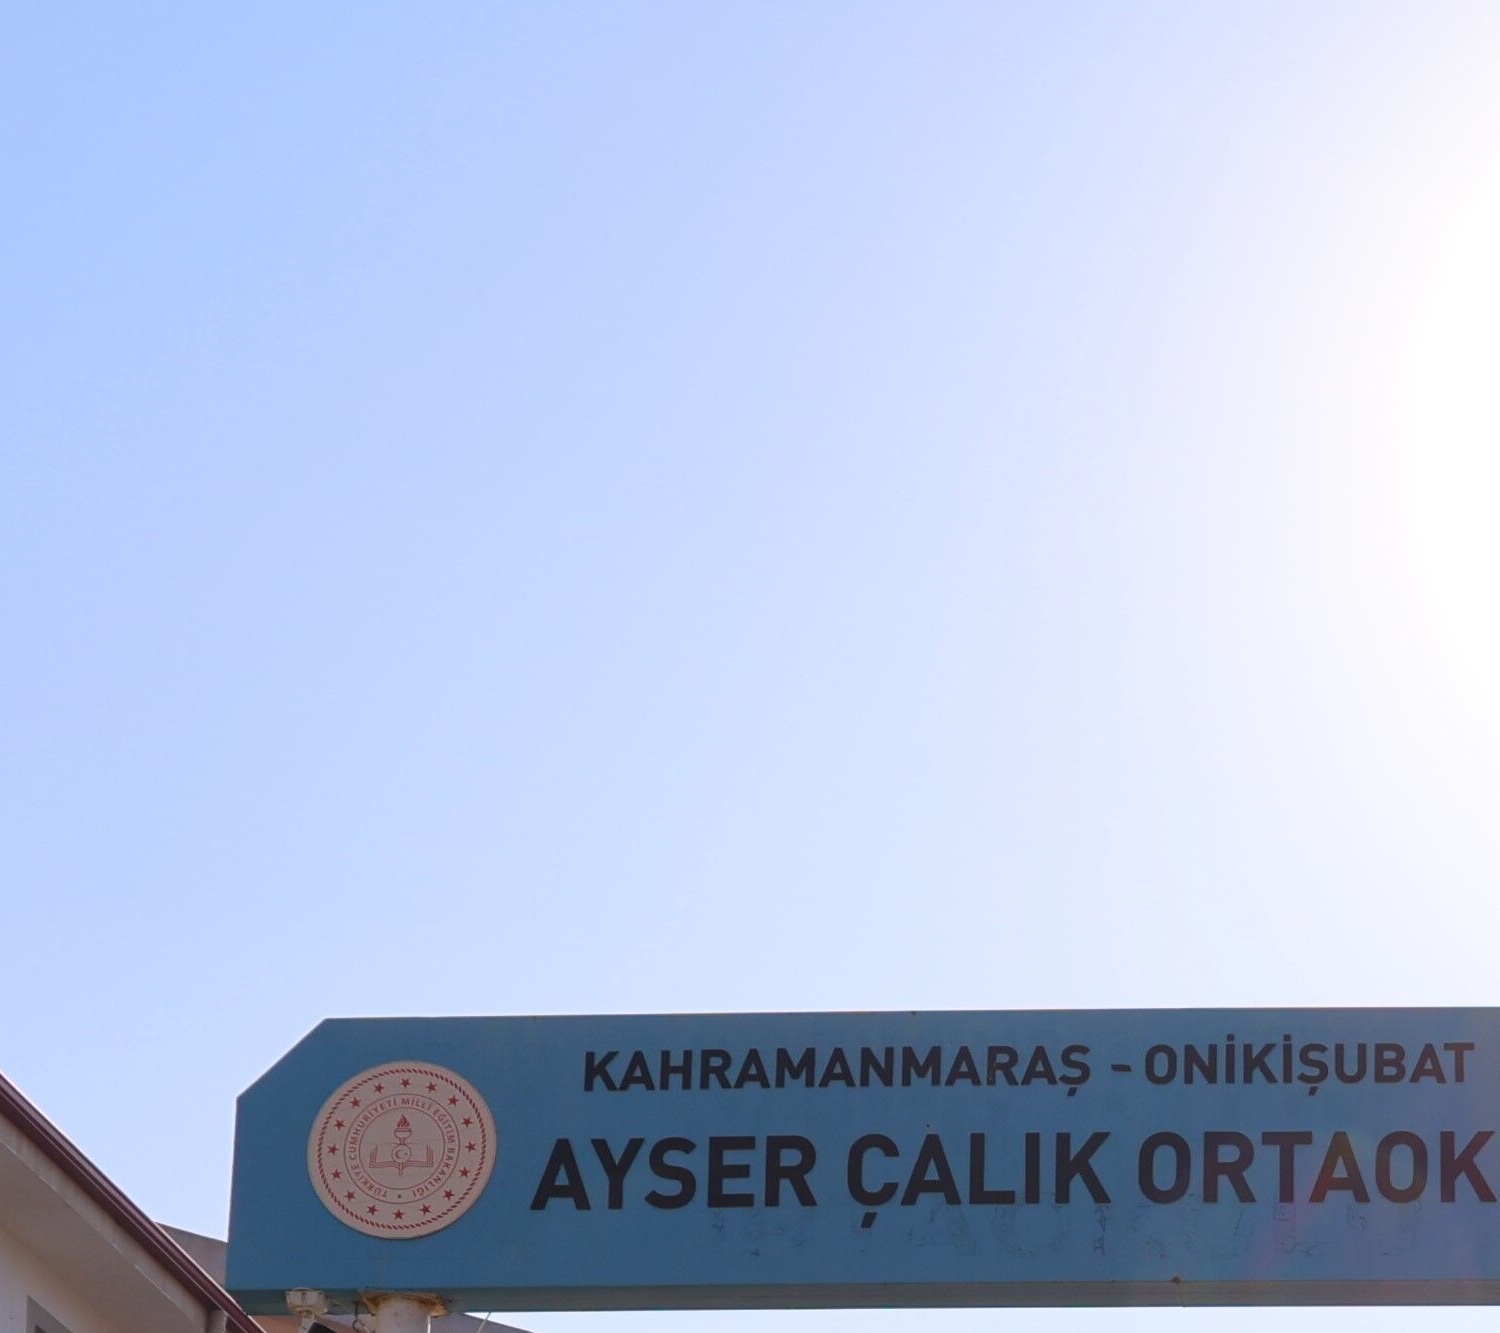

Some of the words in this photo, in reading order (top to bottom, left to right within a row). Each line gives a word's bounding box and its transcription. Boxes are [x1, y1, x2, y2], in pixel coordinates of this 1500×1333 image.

[584, 1045, 1091, 1097] KAHRAMANMARAŞ
[1144, 1034, 1475, 1097] ONİKİŞUBAT
[530, 1135, 818, 1211] AYSER
[847, 1131, 1112, 1229] ÇALIK
